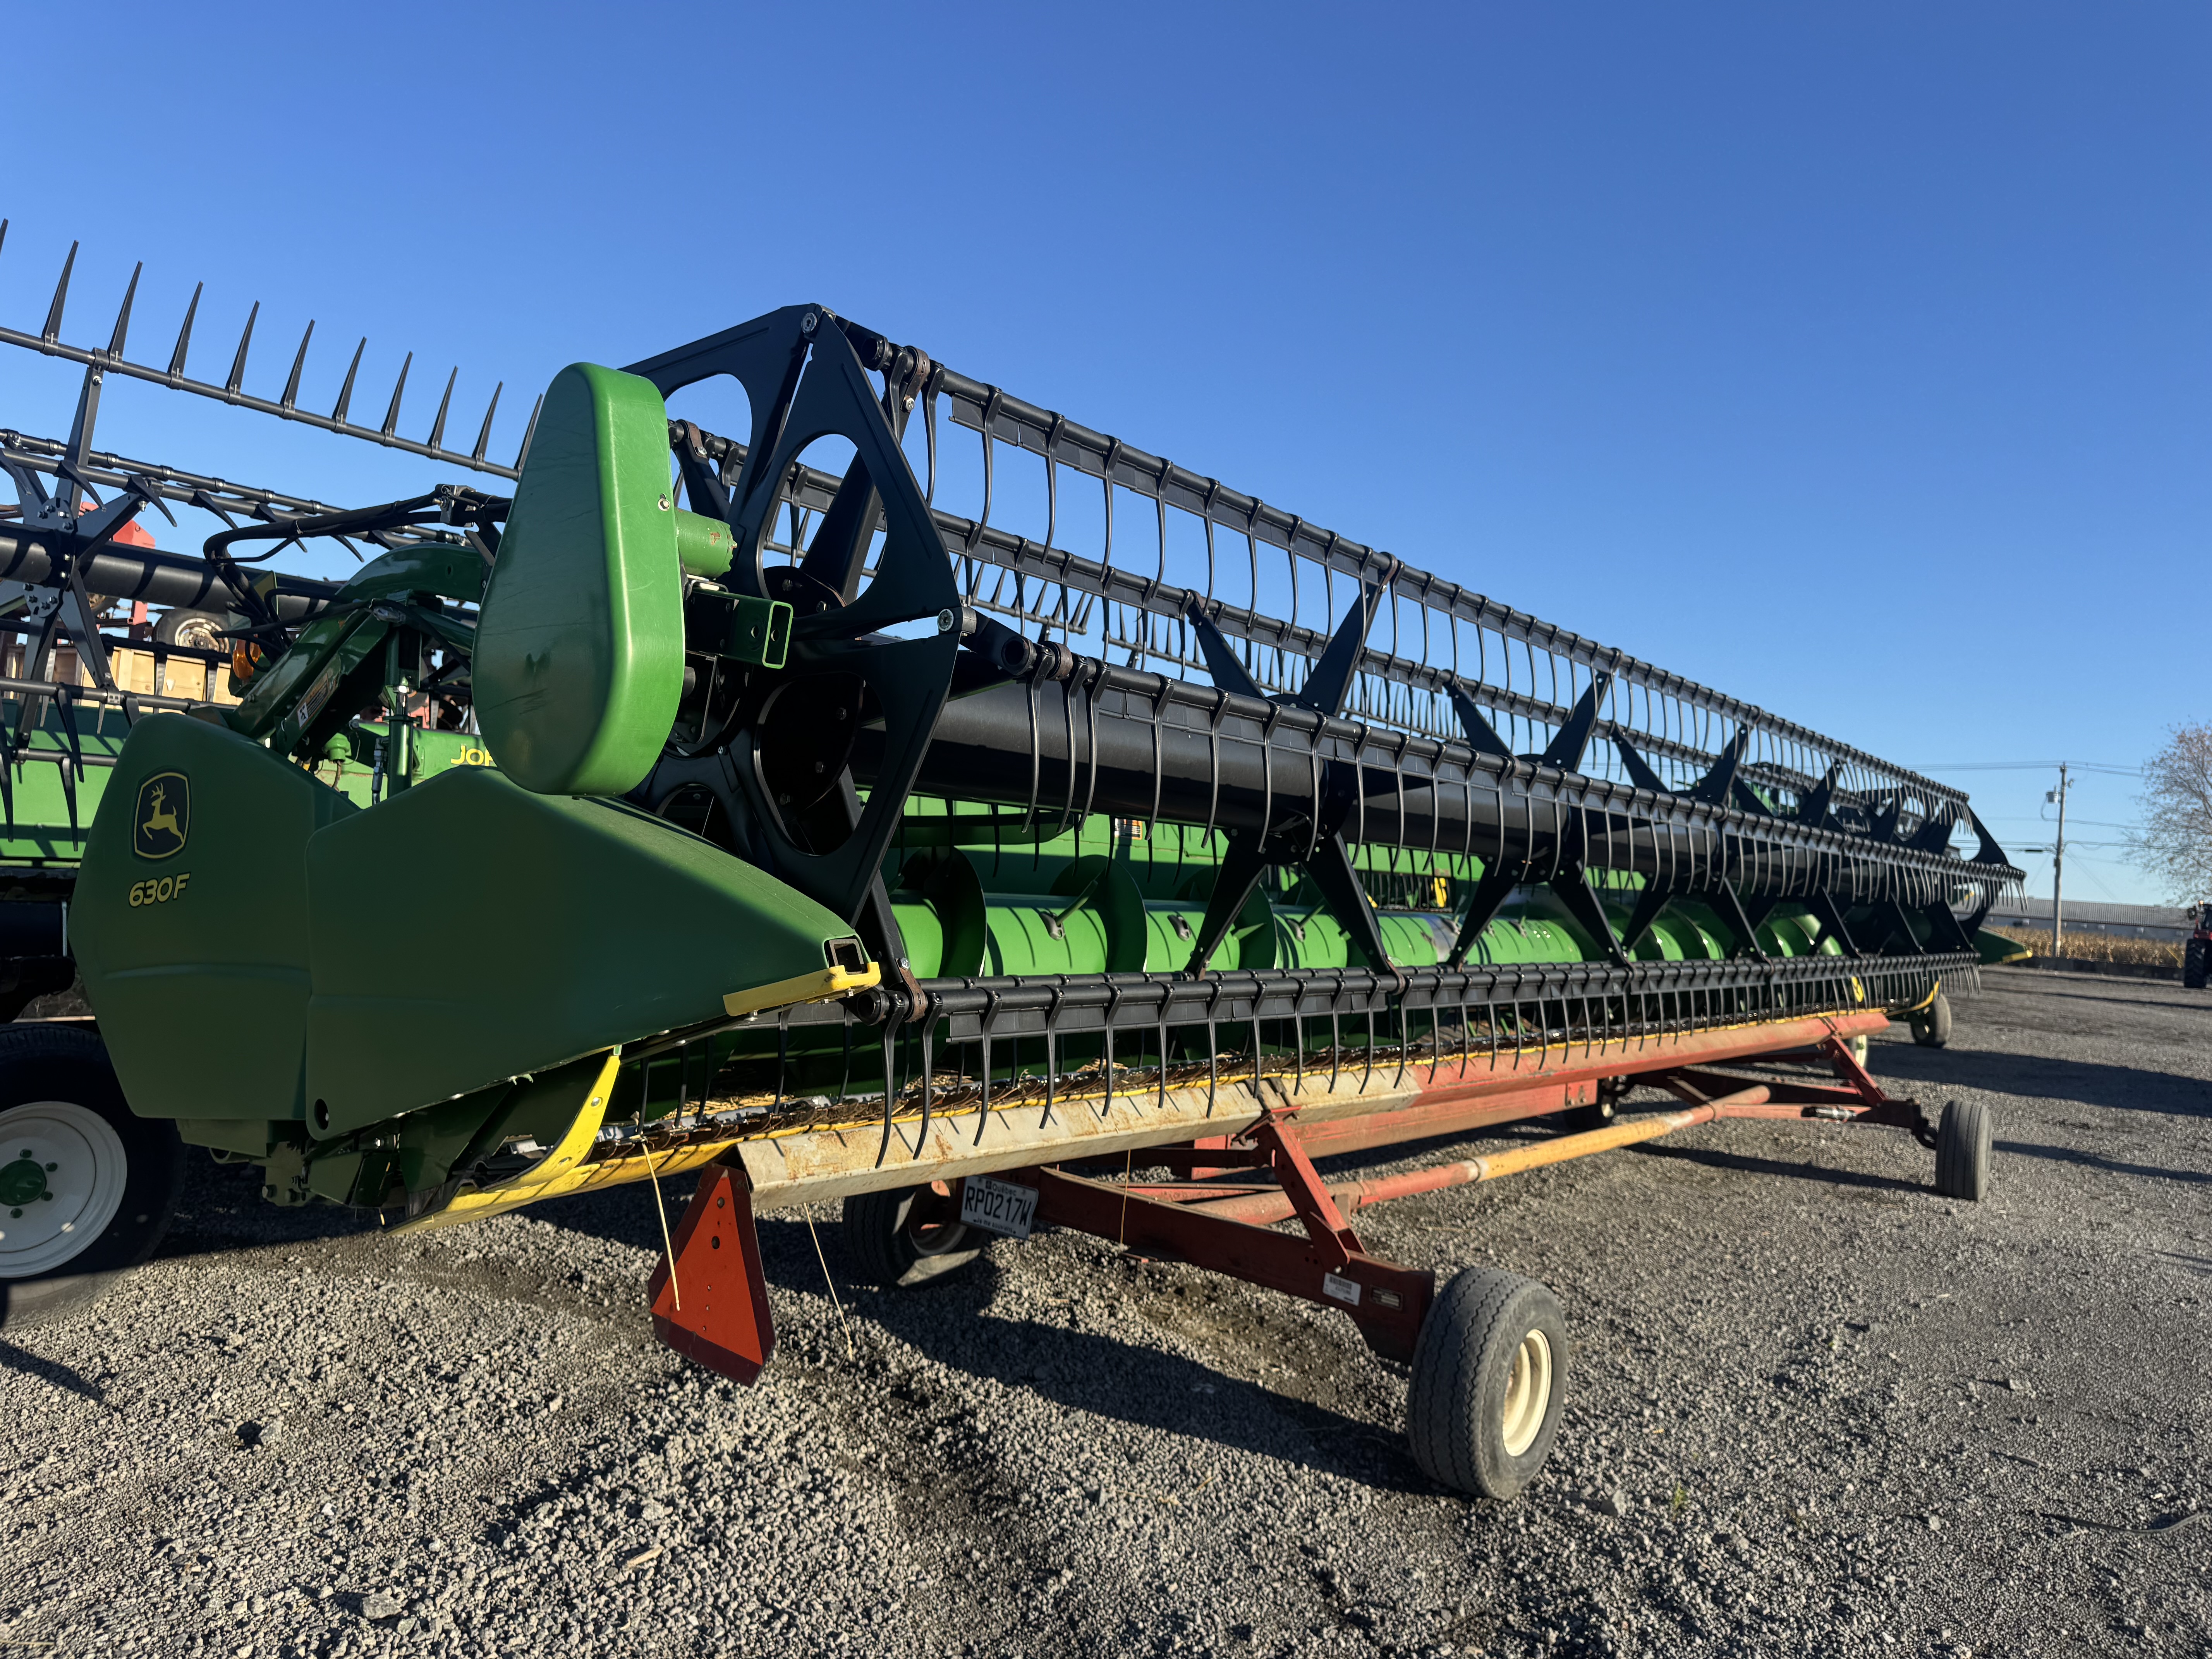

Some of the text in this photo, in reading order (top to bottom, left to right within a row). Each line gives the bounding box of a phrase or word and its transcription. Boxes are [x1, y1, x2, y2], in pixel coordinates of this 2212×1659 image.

[129, 872, 190, 907] 630F
[965, 1186, 1032, 1226] RP0217W
[992, 1183, 1017, 1196] Québec
